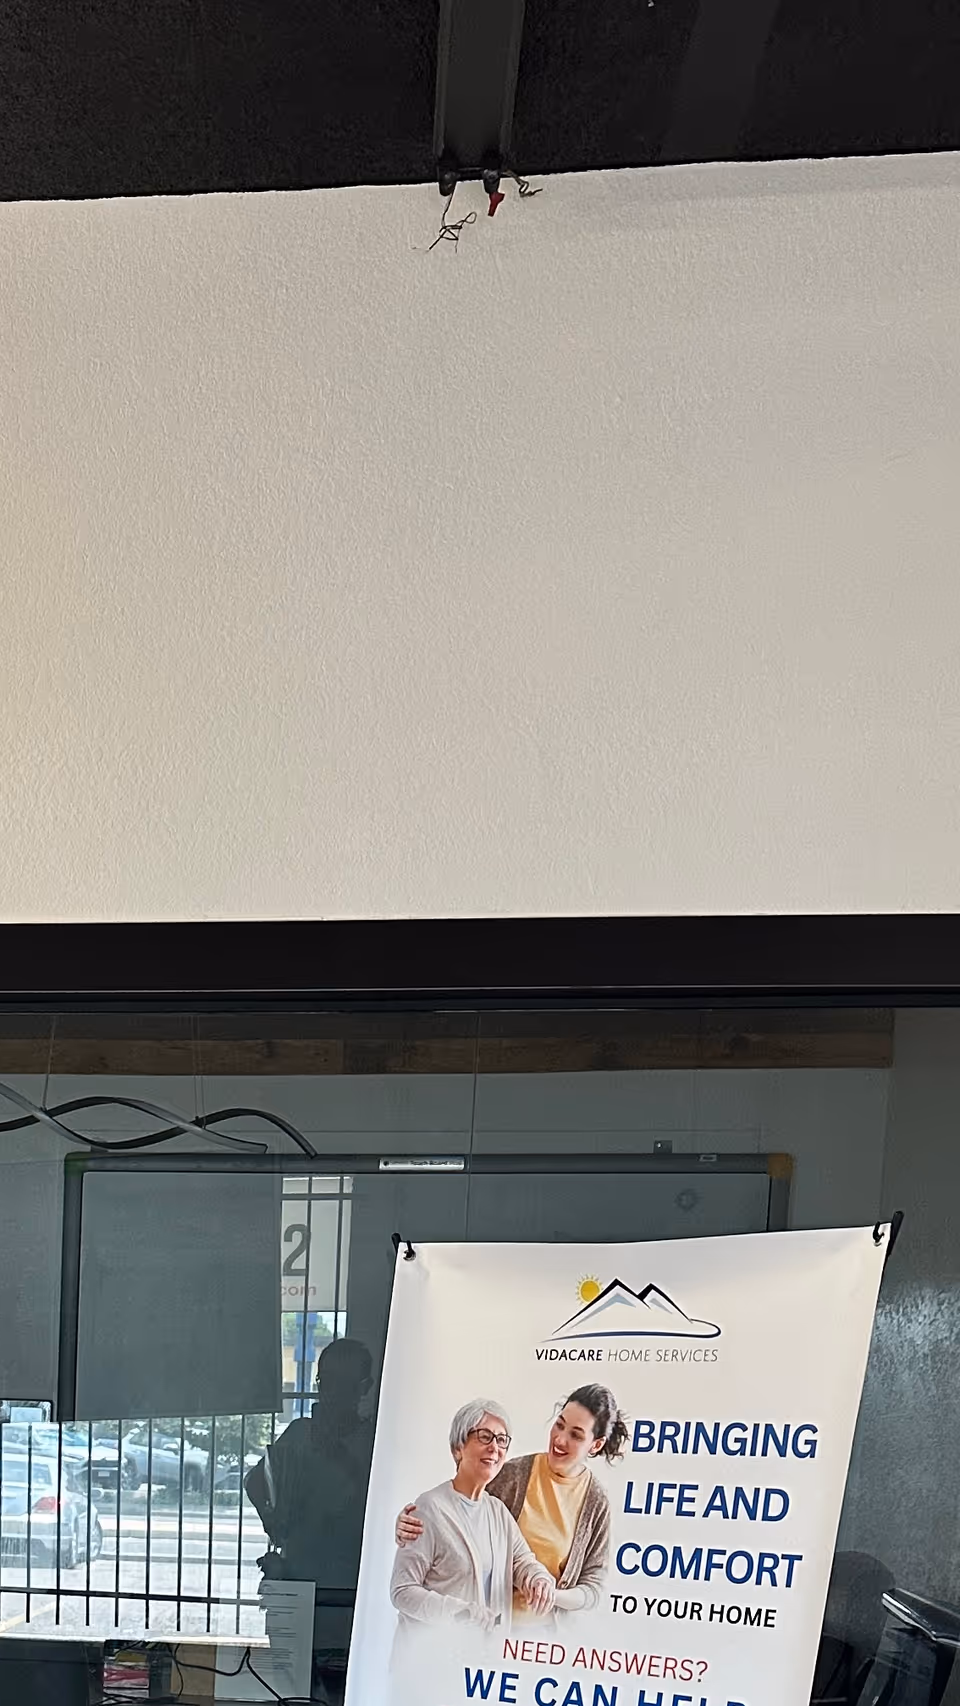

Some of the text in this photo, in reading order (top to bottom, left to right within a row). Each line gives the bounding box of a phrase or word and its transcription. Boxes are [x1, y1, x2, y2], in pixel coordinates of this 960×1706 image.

[282, 1224, 311, 1276] 2
[535, 1349, 718, 1362] VIDACARE HOME SERVICES
[631, 1420, 819, 1459] BRINGING
[623, 1481, 790, 1522] LIFE AND
[616, 1542, 803, 1588] COMFORT
[610, 1594, 777, 1628] TO YOUR HOME
[503, 1638, 708, 1683] NEED ANSWERS?
[464, 1667, 519, 1704] WE
